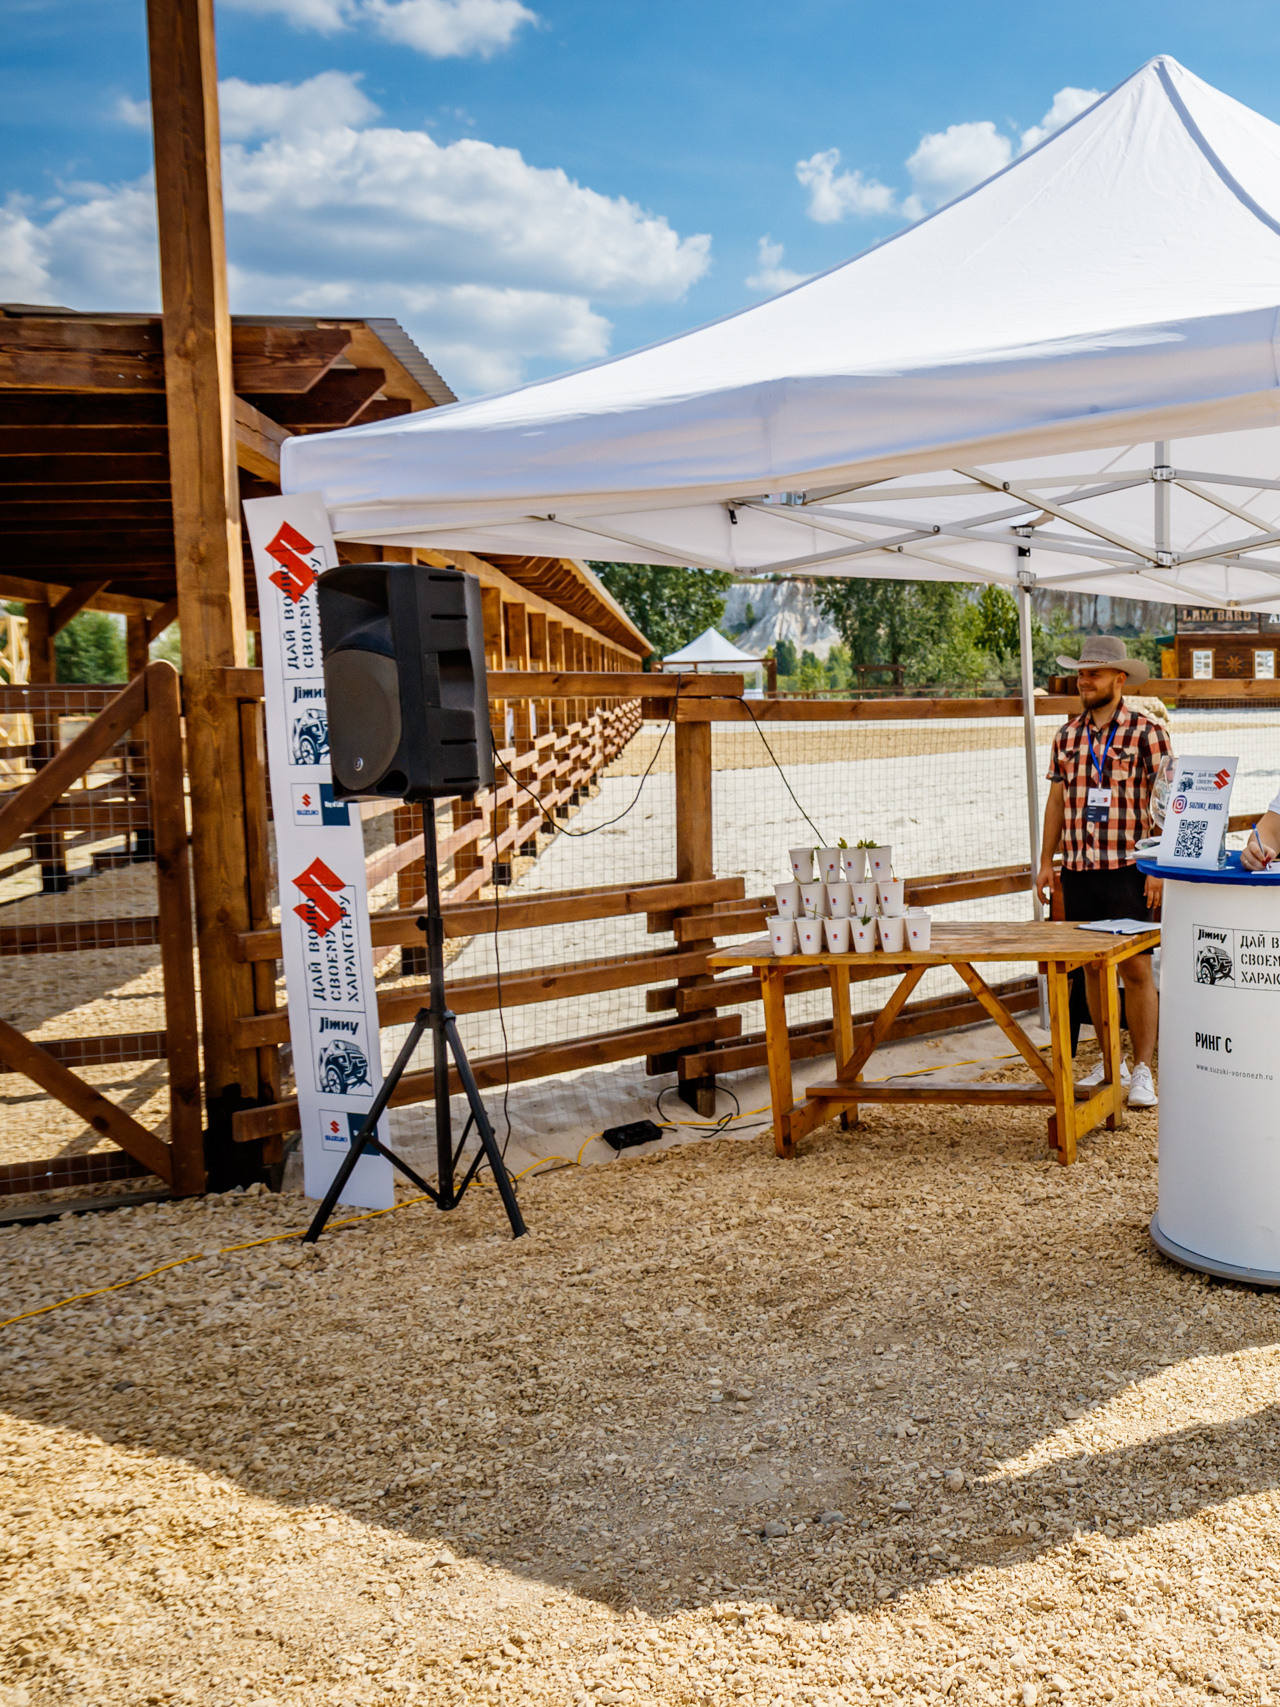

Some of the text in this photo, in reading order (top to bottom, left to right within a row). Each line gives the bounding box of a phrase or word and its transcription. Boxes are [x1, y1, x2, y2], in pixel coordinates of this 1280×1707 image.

[280, 564, 299, 669] ДАЙ ВОЛЮ
[299, 593, 314, 668] СВОЕМУ
[292, 686, 326, 703] Jimn
[1198, 929, 1227, 944] Jimny
[1240, 934, 1266, 949] ДАЙ
[306, 898, 327, 1001] ДАЙ ВОЛЮ
[339, 895, 359, 1002] ХАРАКТЕРУ
[324, 927, 342, 1001] СВОЕМУ
[319, 1016, 359, 1035] Jimny
[1195, 1032, 1221, 1051] РИНГ
[1196, 1064, 1273, 1080] www.suzuki-voronezh.ru
